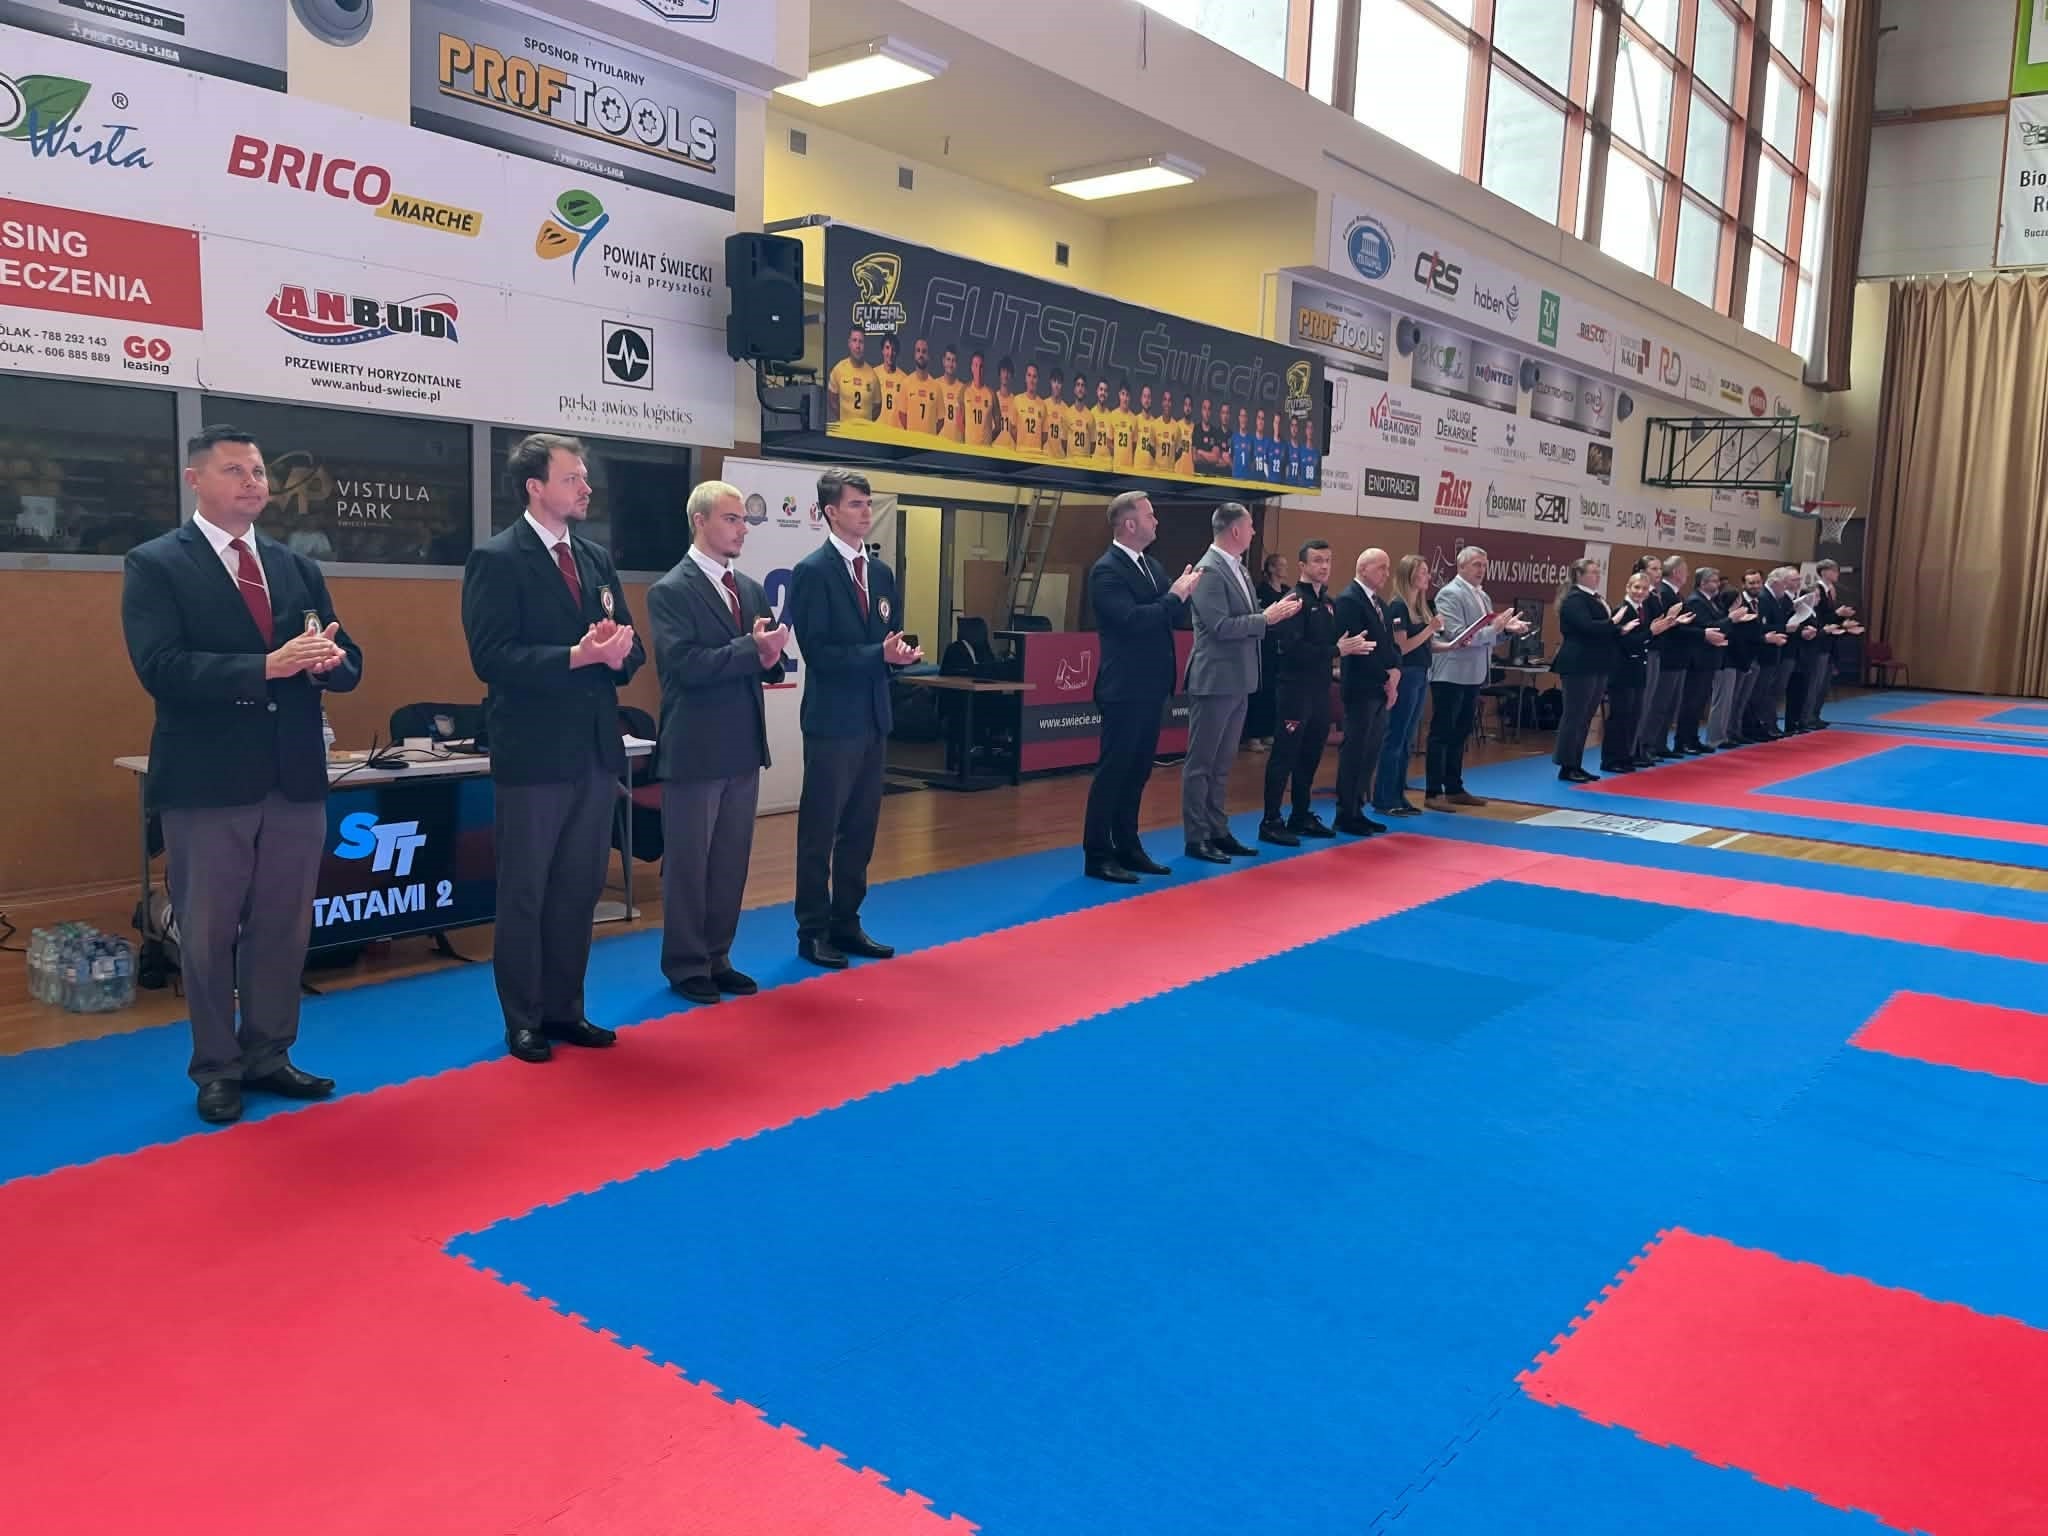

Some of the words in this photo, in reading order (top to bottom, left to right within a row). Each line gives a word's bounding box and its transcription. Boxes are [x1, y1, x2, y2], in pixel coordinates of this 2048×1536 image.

[524, 37, 579, 64] SPOSNOR
[583, 57, 645, 87] TYTULARNY
[439, 32, 717, 163] PROFTOOLS
[30, 108, 153, 168] Wisła
[227, 134, 391, 205] BRICO
[2020, 171, 2048, 187] Bio
[0, 221, 88, 258] SING
[603, 244, 656, 271] POWIAT
[660, 252, 712, 283] ŚWIECKI
[604, 265, 641, 284] Twoja
[648, 277, 712, 297] przyszłość
[856, 306, 904, 321] FUTSAL
[42, 331, 61, 341] 788
[65, 333, 85, 344] 292
[89, 335, 107, 346] 143
[920, 276, 1130, 378] FUTSAL
[1134, 322, 1281, 402] Świecie
[1298, 307, 1384, 355] PROFTOOLS
[45, 347, 64, 358] 606
[123, 358, 170, 374] leasing
[285, 356, 363, 377] PRZEWIERTY
[367, 367, 462, 389] HORYZONTALNE
[311, 376, 441, 403] www.anbud-swiecie.pl
[853, 391, 862, 410] 2
[886, 394, 893, 410] 6
[643, 401, 693, 424] logistics
[919, 403, 926, 419] 7
[946, 404, 954, 421] 8
[973, 408, 983, 425] 10
[1025, 418, 1036, 435] 12
[1050, 423, 1059, 440] 19
[1074, 431, 1085, 448] 20
[1097, 431, 1107, 446] 21
[1118, 432, 1128, 447] 23
[337, 480, 430, 502] VISTULA
[1368, 474, 1416, 496] ENOTRADEX
[337, 501, 392, 519] PARK
[1491, 495, 1526, 513] BOGMAT
[1486, 554, 1569, 585] ww.swiecie.e
[1039, 714, 1101, 729] www.swiecie.eu
[334, 812, 427, 877] STT
[312, 883, 425, 928] TATAMI
[436, 879, 453, 908] 2
